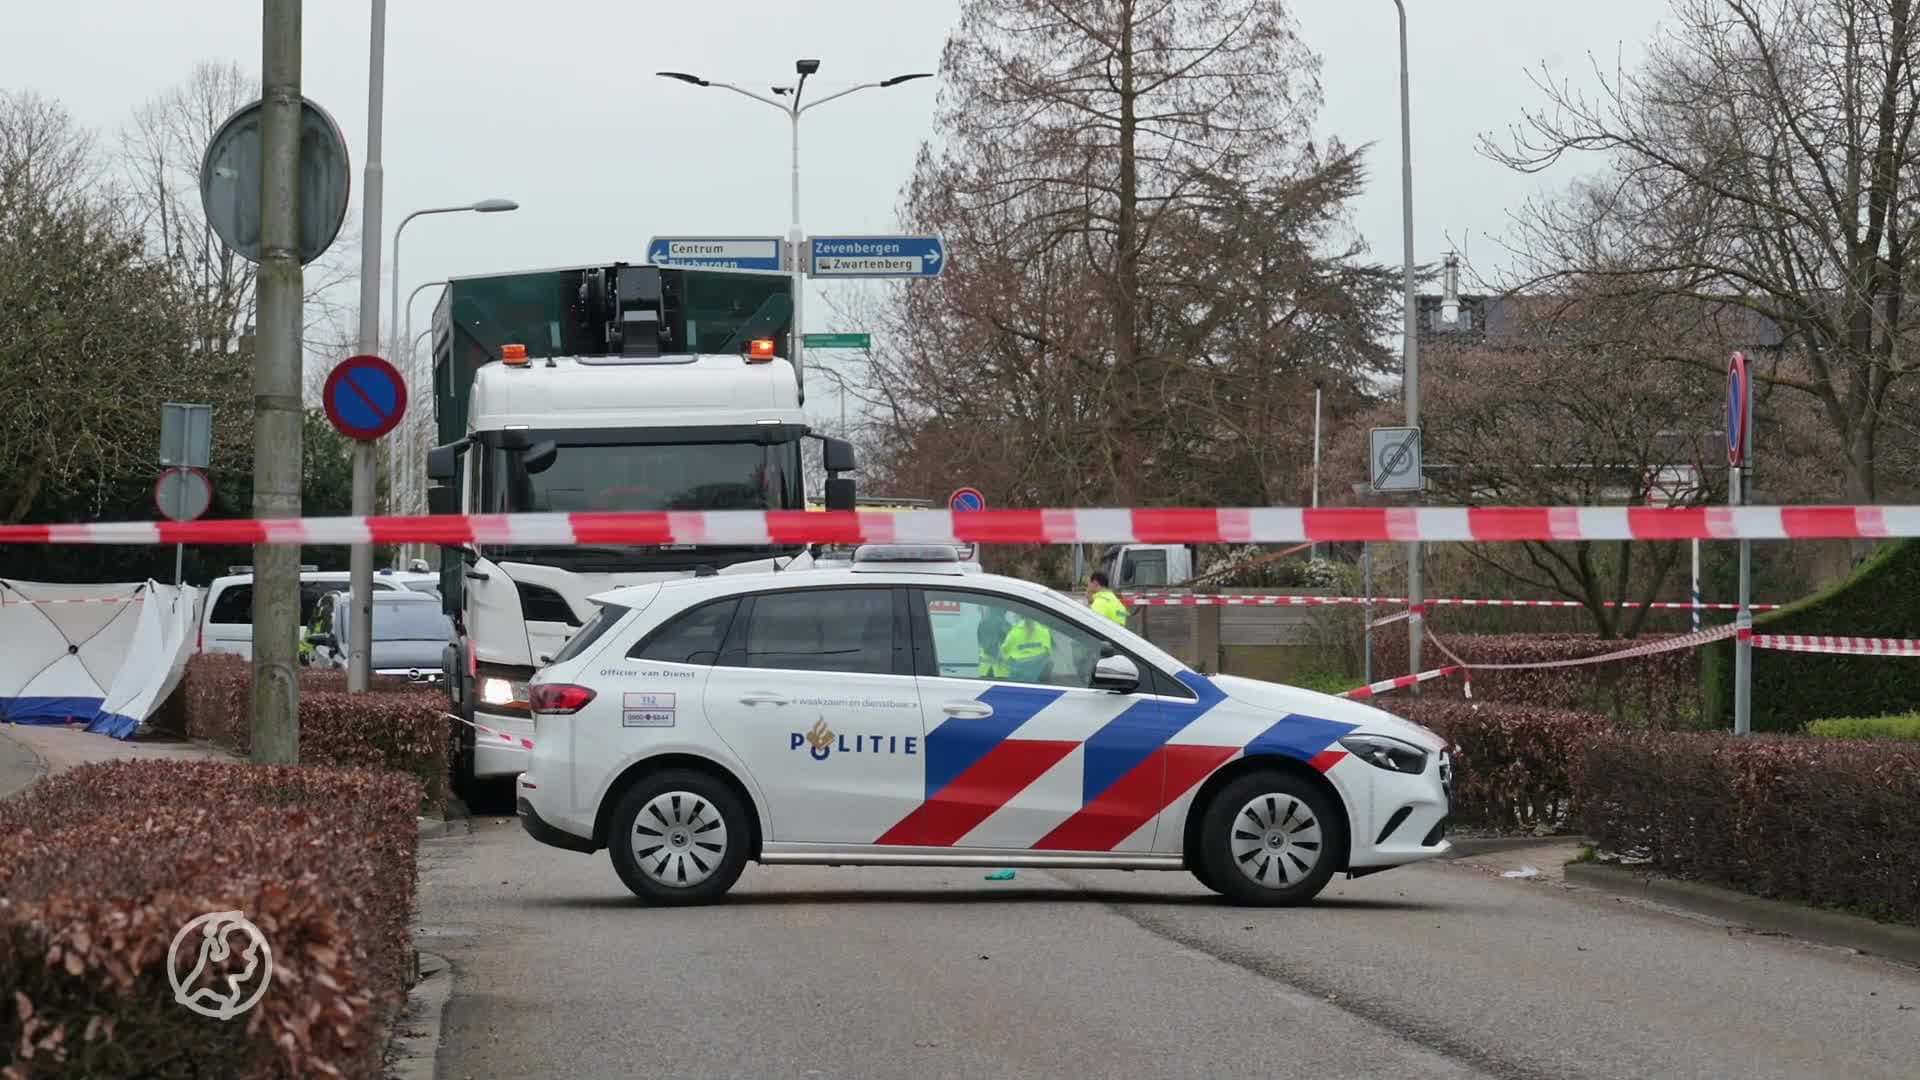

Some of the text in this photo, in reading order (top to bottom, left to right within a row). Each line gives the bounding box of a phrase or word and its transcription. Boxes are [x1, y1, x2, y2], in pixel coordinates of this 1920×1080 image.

[671, 243, 724, 254] Centrum
[815, 242, 900, 255] Zevenbergen
[834, 259, 913, 271] Zwartenberg
[600, 669, 637, 677] Officier
[663, 670, 695, 678] Dienst
[642, 696, 656, 704] 112
[791, 733, 917, 760] POLITIE
